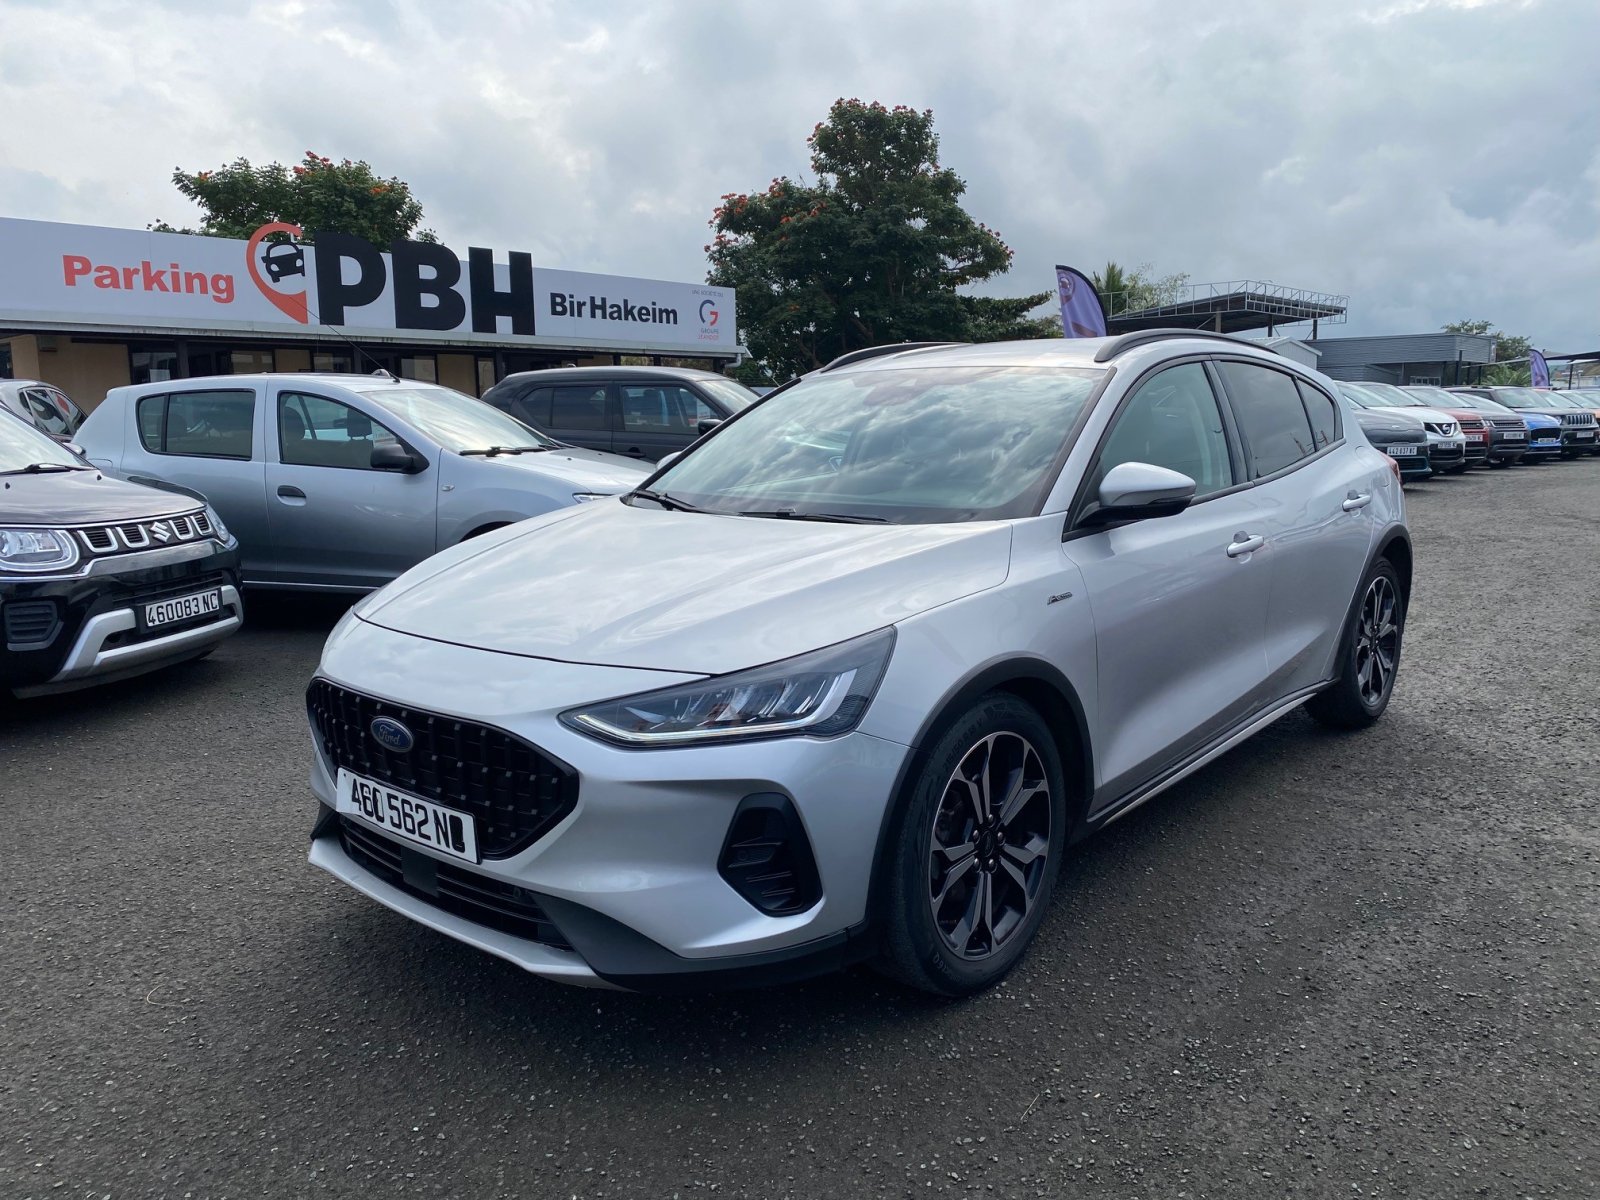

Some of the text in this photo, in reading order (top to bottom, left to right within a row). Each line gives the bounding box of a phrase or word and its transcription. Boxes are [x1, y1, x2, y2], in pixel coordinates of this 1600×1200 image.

[63, 254, 235, 304] Parking
[313, 233, 535, 336] PBH
[550, 292, 678, 325] Bir Hakeim
[148, 592, 218, 625] 460083 NC
[379, 724, 401, 745] Ford
[352, 778, 385, 824] 460
[386, 793, 432, 841] 562
